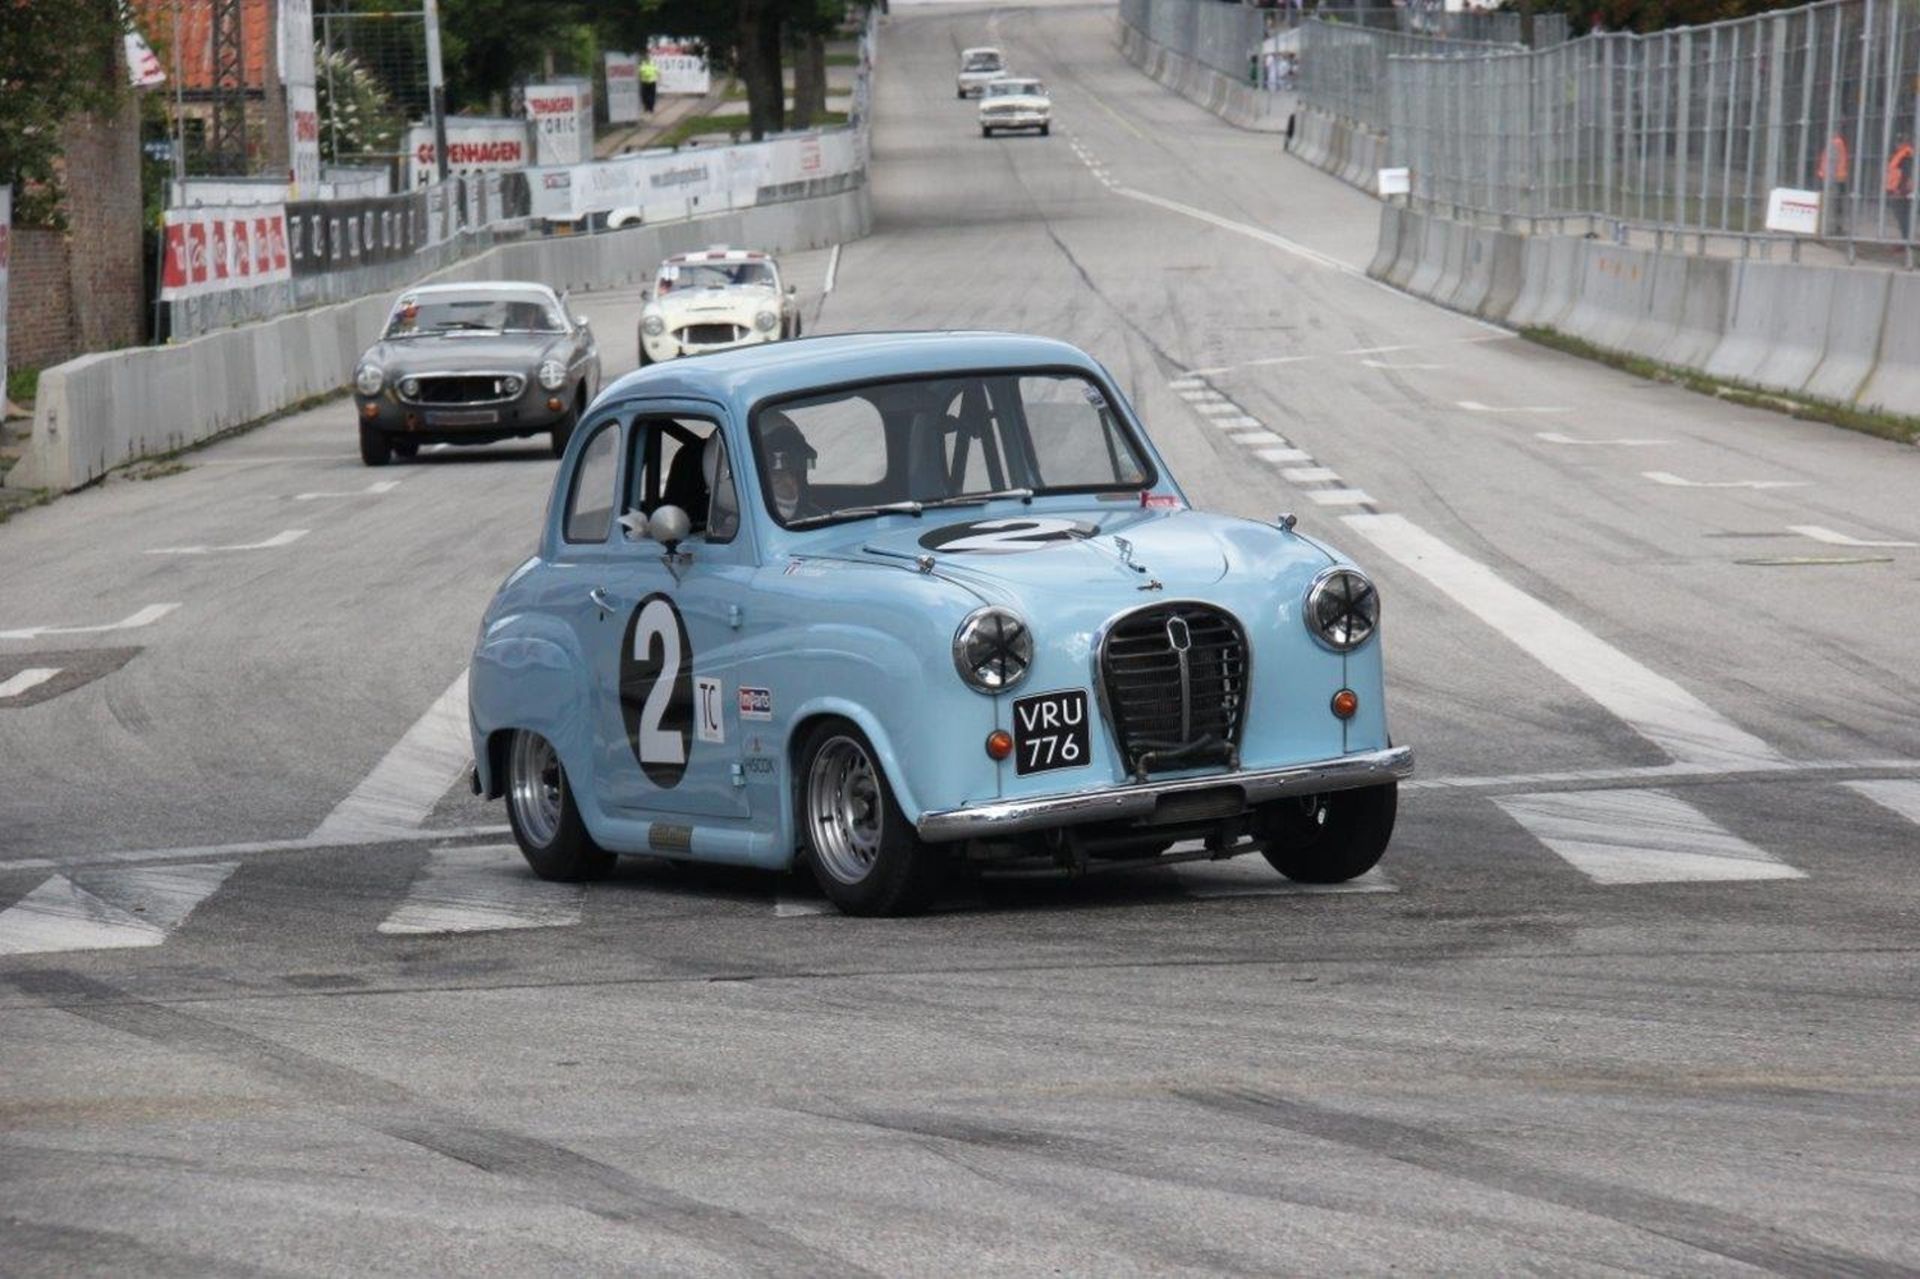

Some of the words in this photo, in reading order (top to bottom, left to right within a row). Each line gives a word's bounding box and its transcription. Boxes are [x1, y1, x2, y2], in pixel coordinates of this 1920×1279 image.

[935, 518, 1090, 551] 2
[634, 599, 685, 764] 2
[699, 683, 718, 731] TC
[1019, 698, 1082, 731] VRU
[1025, 733, 1079, 767] 776
